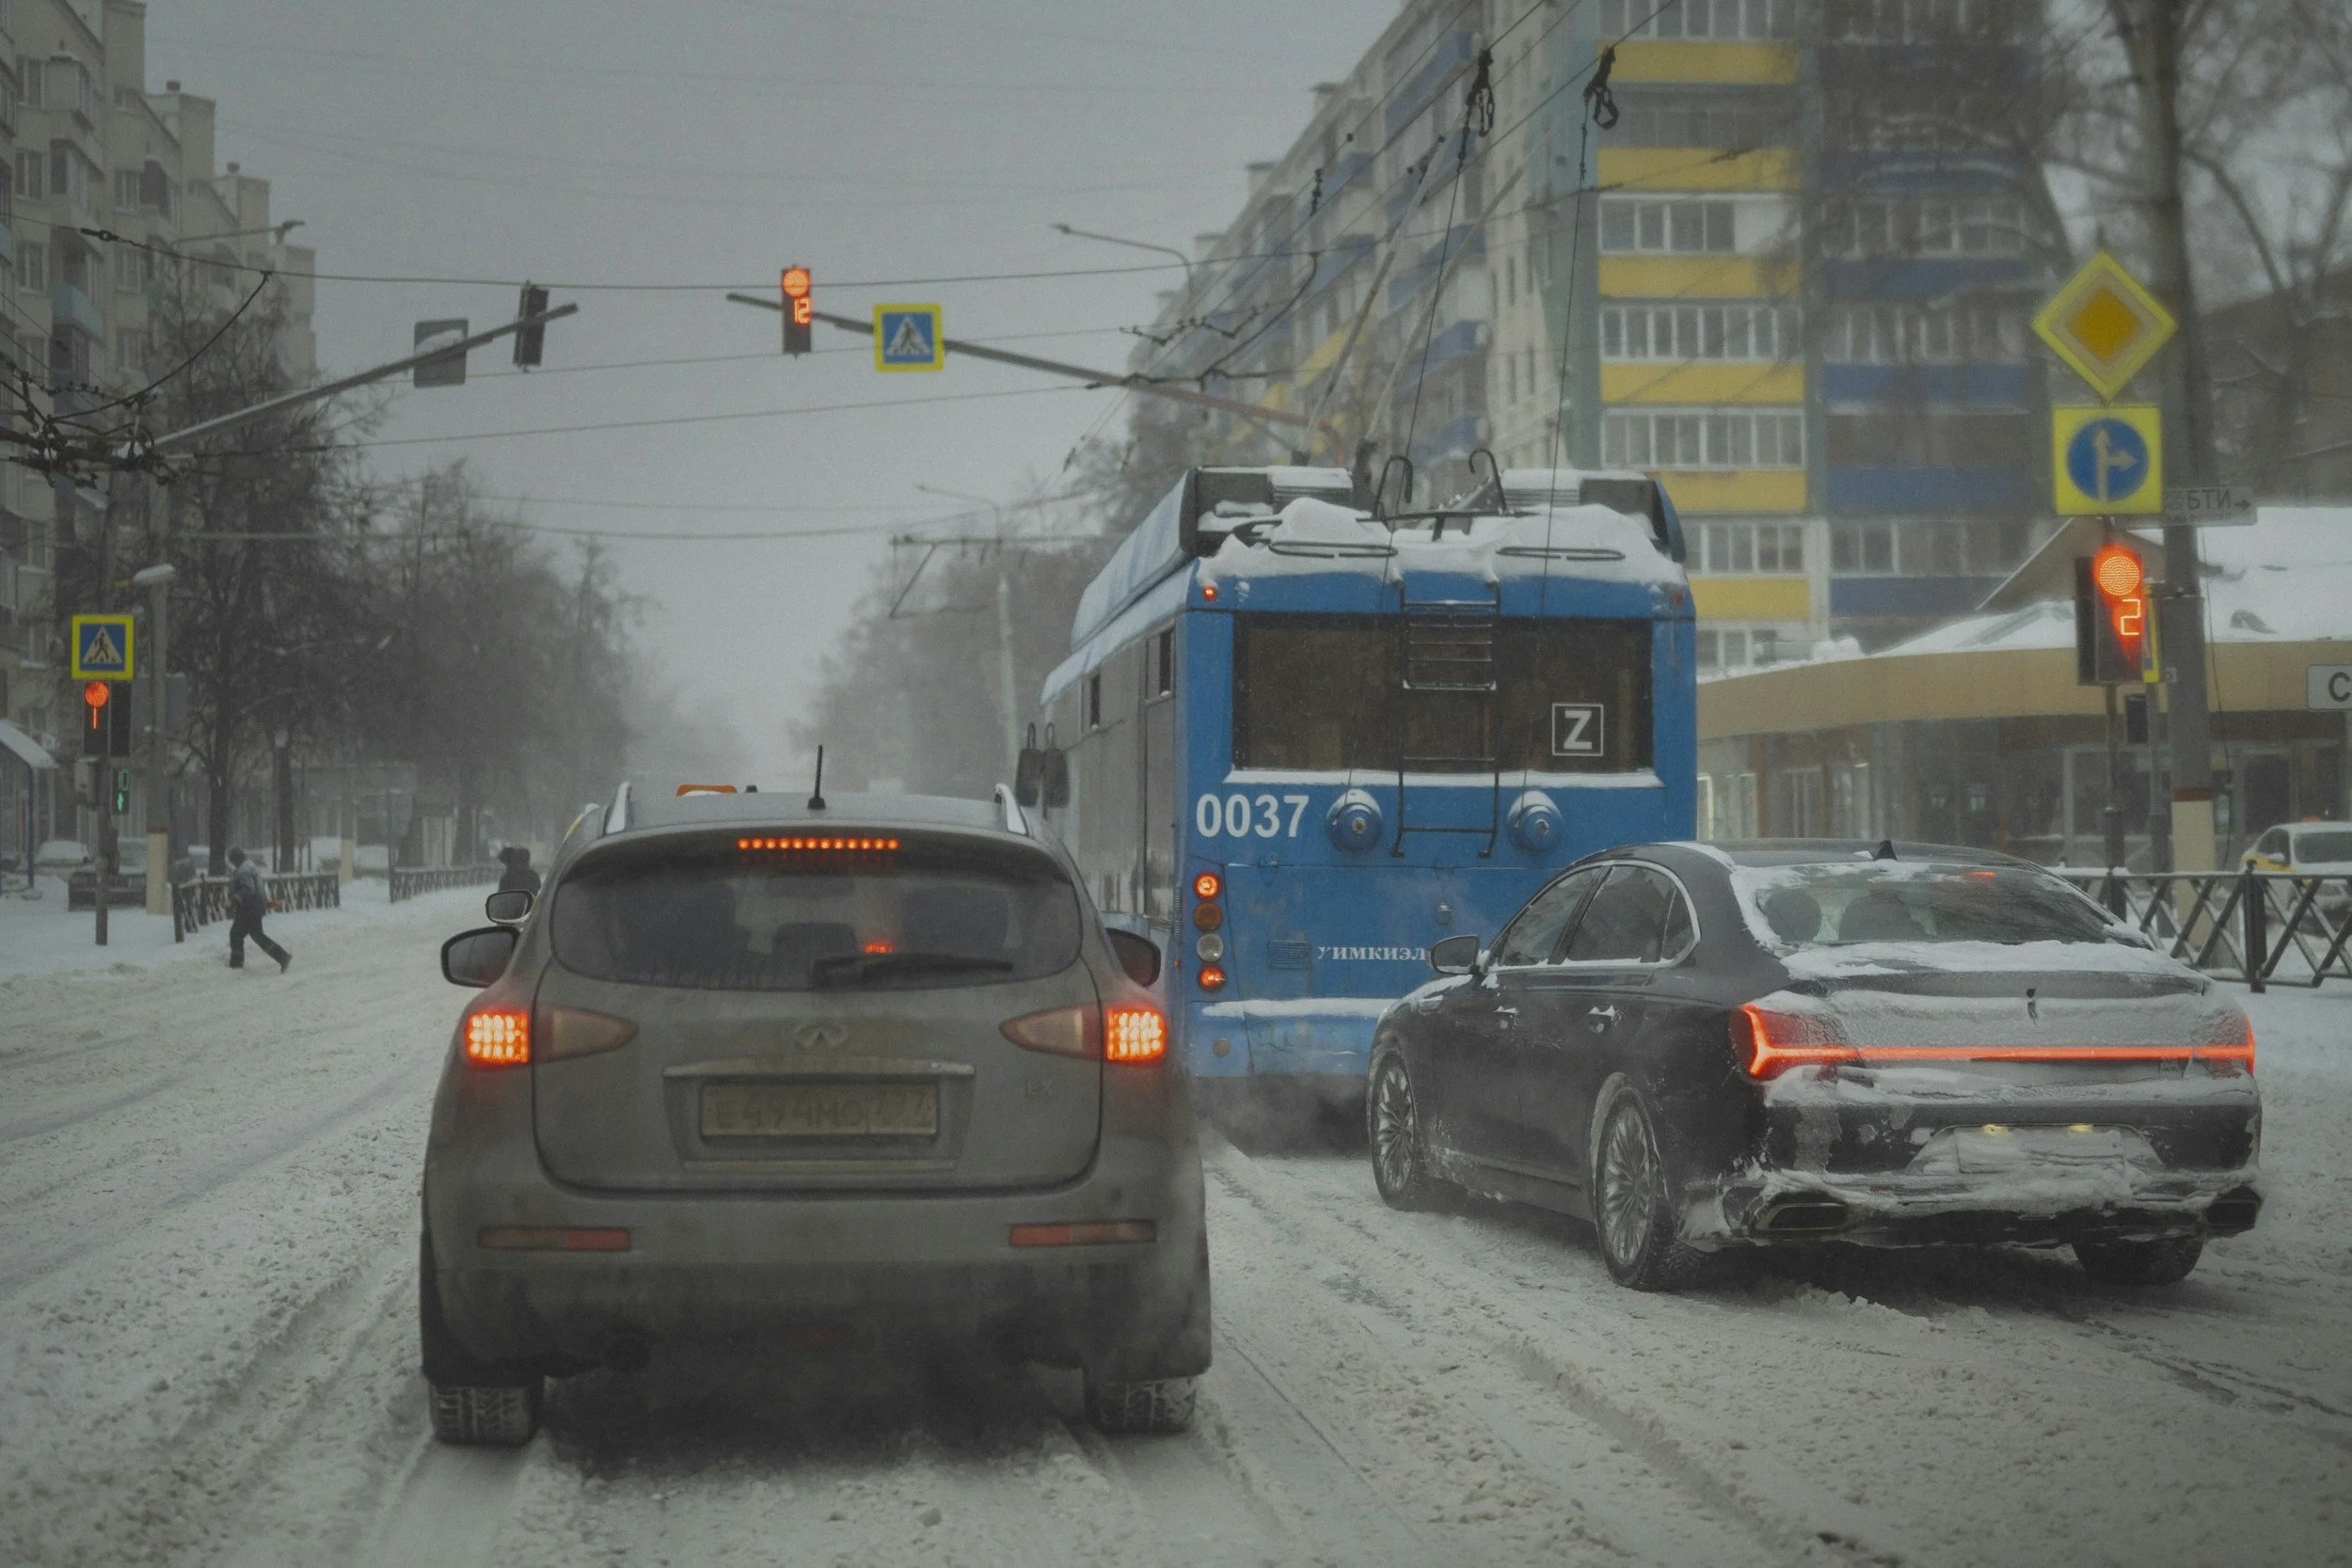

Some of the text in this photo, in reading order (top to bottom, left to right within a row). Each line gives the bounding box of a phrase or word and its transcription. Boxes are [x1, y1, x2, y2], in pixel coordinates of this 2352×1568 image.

[794, 297, 812, 325] 12
[2186, 488, 2232, 510] БТИ
[2120, 598, 2141, 636] 2
[1564, 710, 1592, 750] Z
[1196, 794, 1310, 838] 0037
